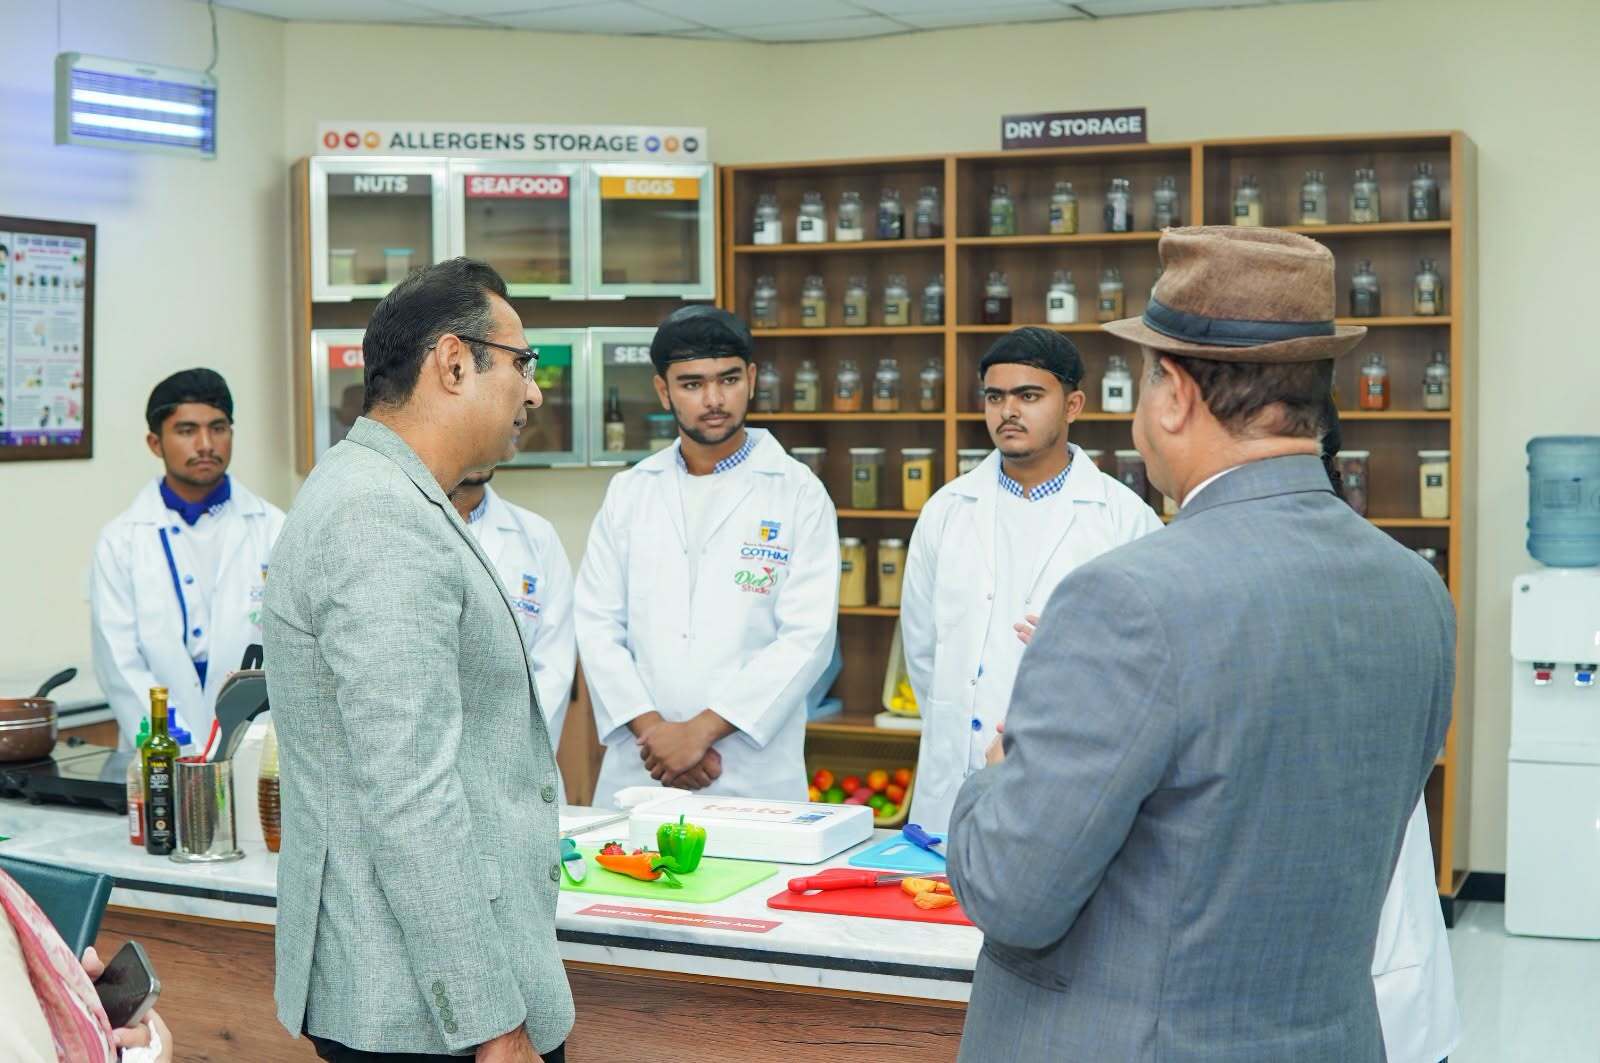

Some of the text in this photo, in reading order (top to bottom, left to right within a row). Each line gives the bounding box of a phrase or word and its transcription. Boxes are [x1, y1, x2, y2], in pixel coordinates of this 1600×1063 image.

[1005, 115, 1142, 139] DRY STORAGE
[389, 132, 639, 153] ALLERGENS STORAGE
[354, 176, 408, 193] NUTS
[471, 177, 565, 195] SEAFOOD
[624, 179, 675, 195] EGGS
[614, 346, 652, 363] SES
[741, 547, 788, 561] COTHM
